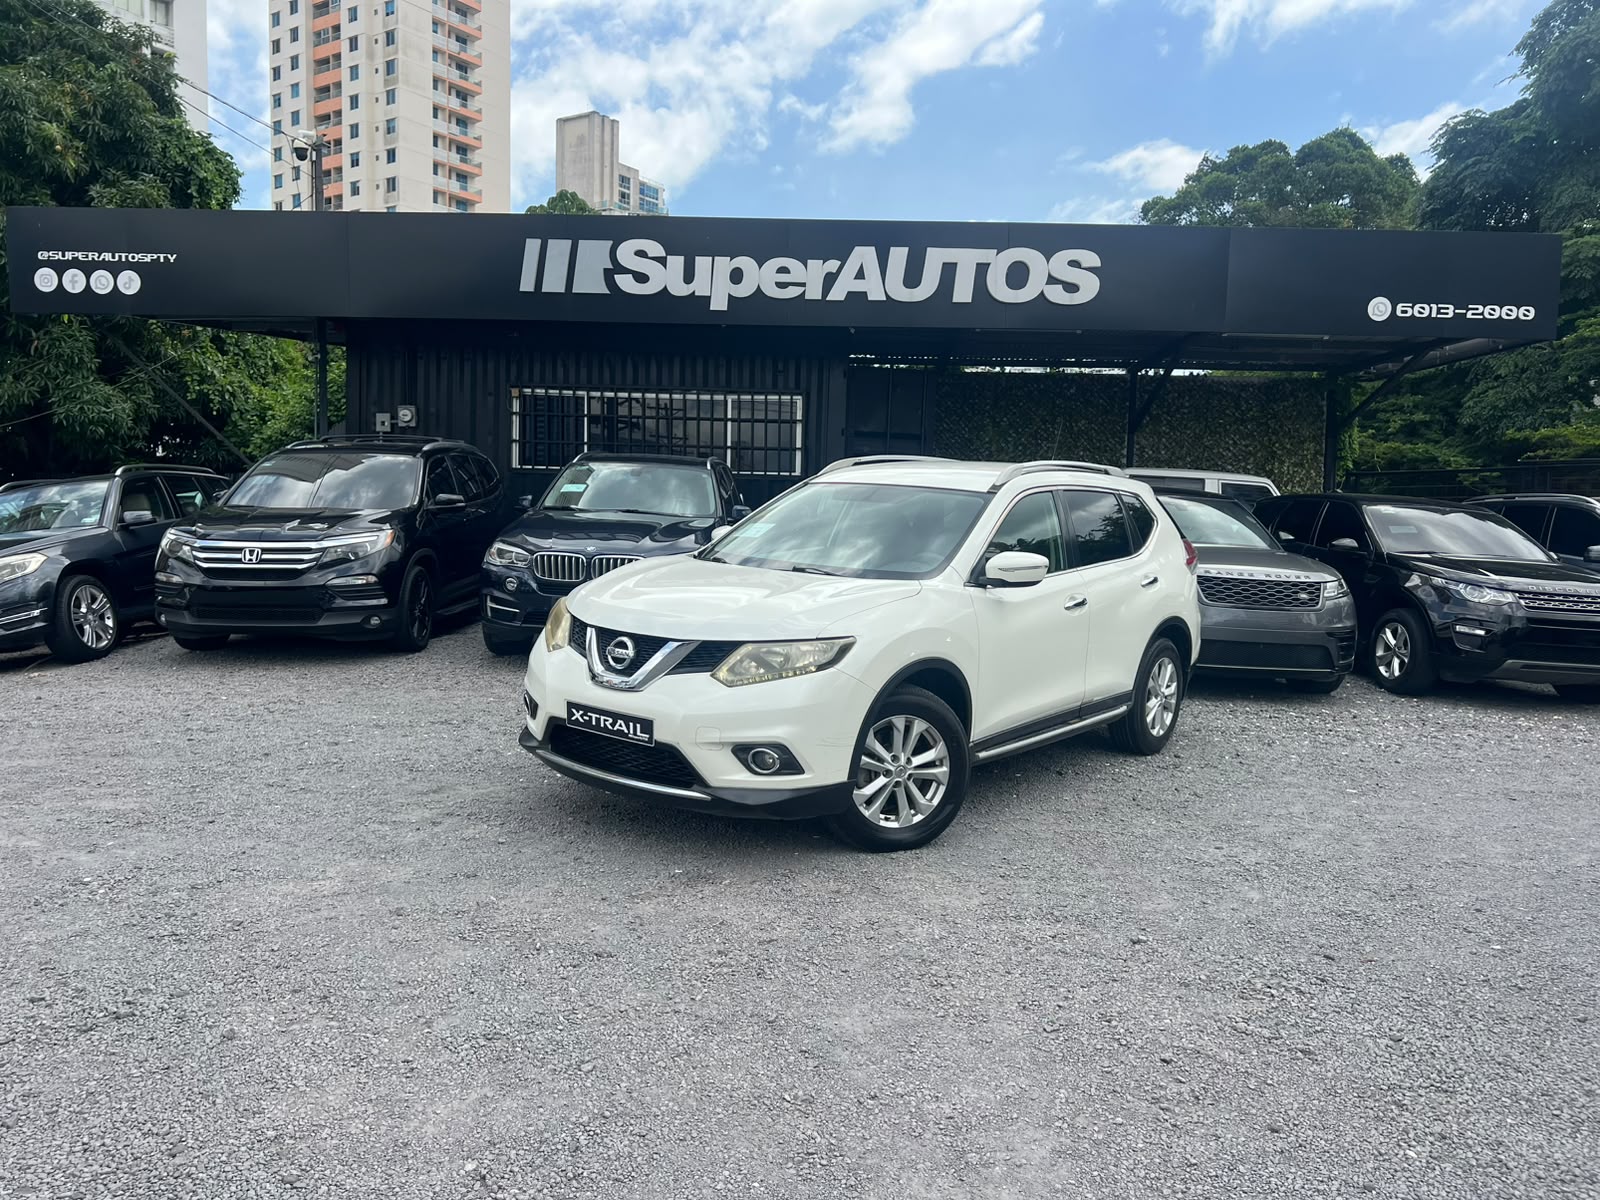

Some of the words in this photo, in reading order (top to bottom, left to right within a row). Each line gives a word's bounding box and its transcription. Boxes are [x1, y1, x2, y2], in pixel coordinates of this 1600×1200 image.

[37, 250, 178, 263] @SUPERAUTOSPTY
[613, 238, 1102, 311] SuperAUTOS
[1395, 302, 1536, 321] 6013-2000
[1203, 569, 1256, 578] RANGE
[1527, 585, 1600, 594] DISCOVE
[570, 707, 651, 738] X-TRAIL
